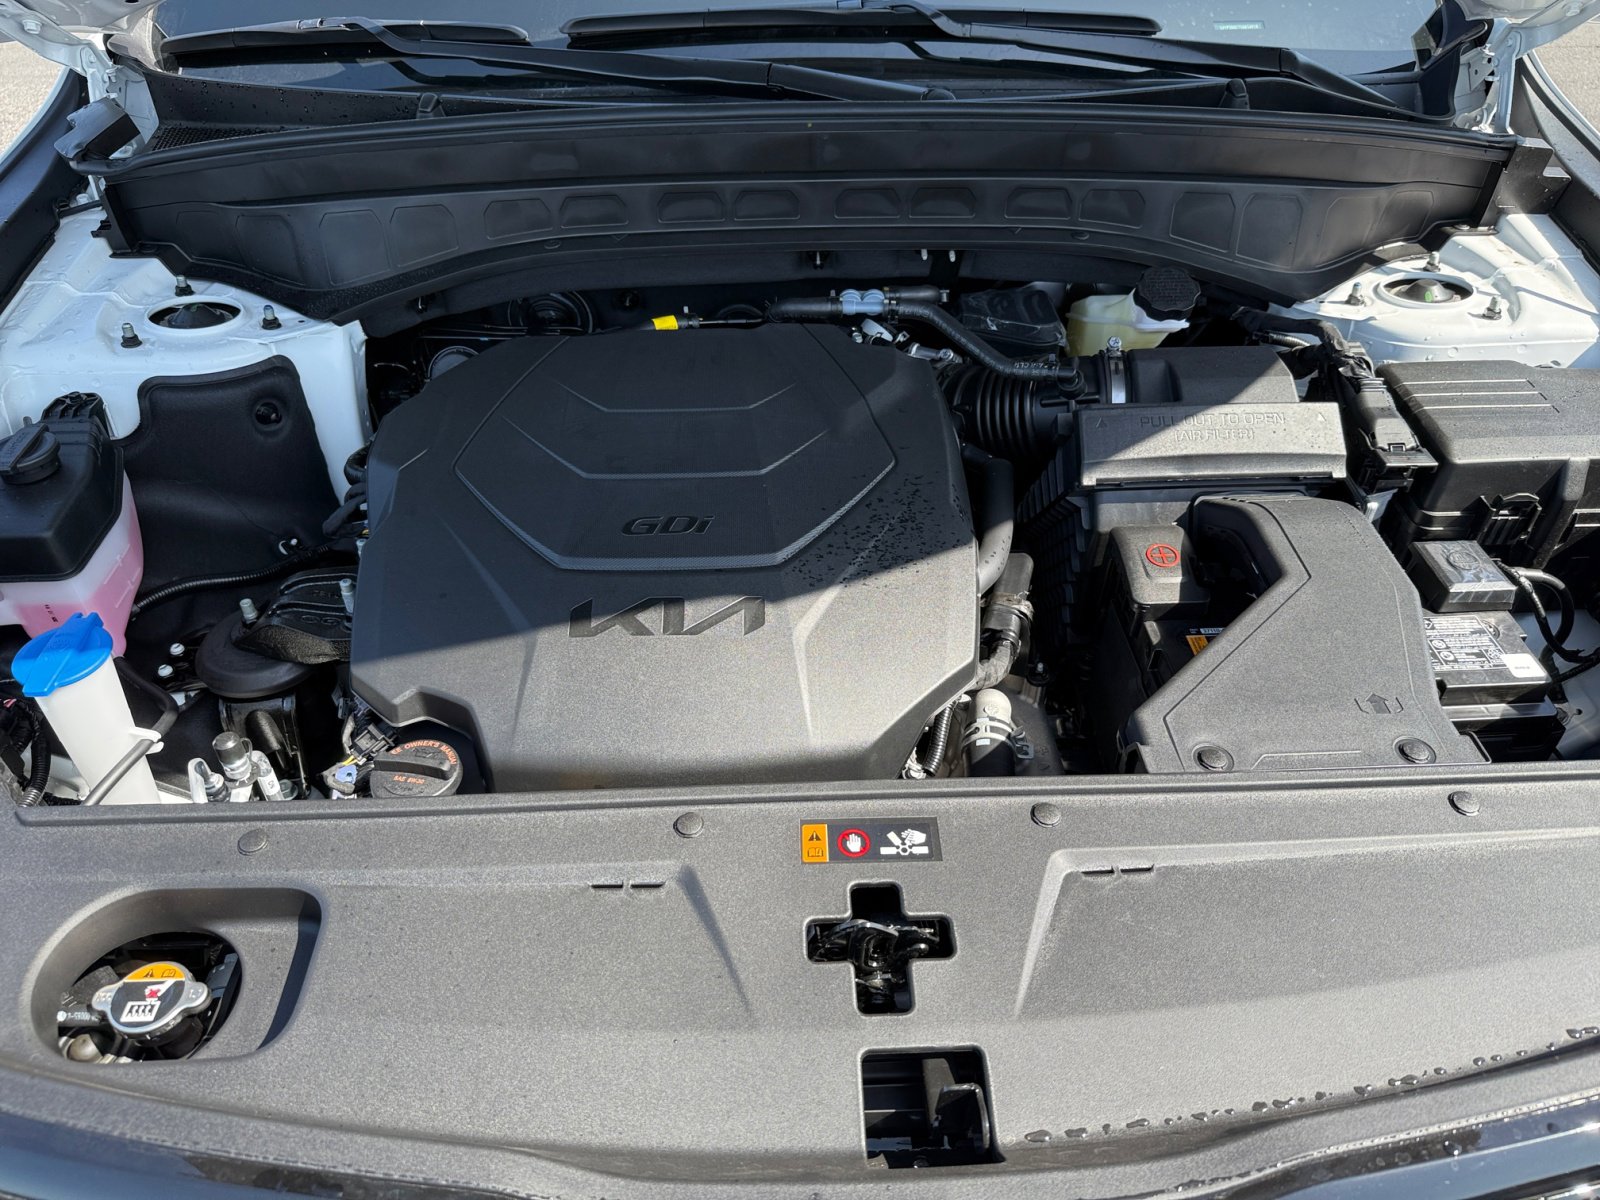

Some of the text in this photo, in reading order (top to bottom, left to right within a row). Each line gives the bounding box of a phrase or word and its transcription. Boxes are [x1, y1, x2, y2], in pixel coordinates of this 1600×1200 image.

[1140, 411, 1286, 428] PULL OUT TO OPEN
[621, 515, 716, 537] GDi
[568, 595, 766, 638] KIA
[403, 740, 440, 749] OWNER'S
